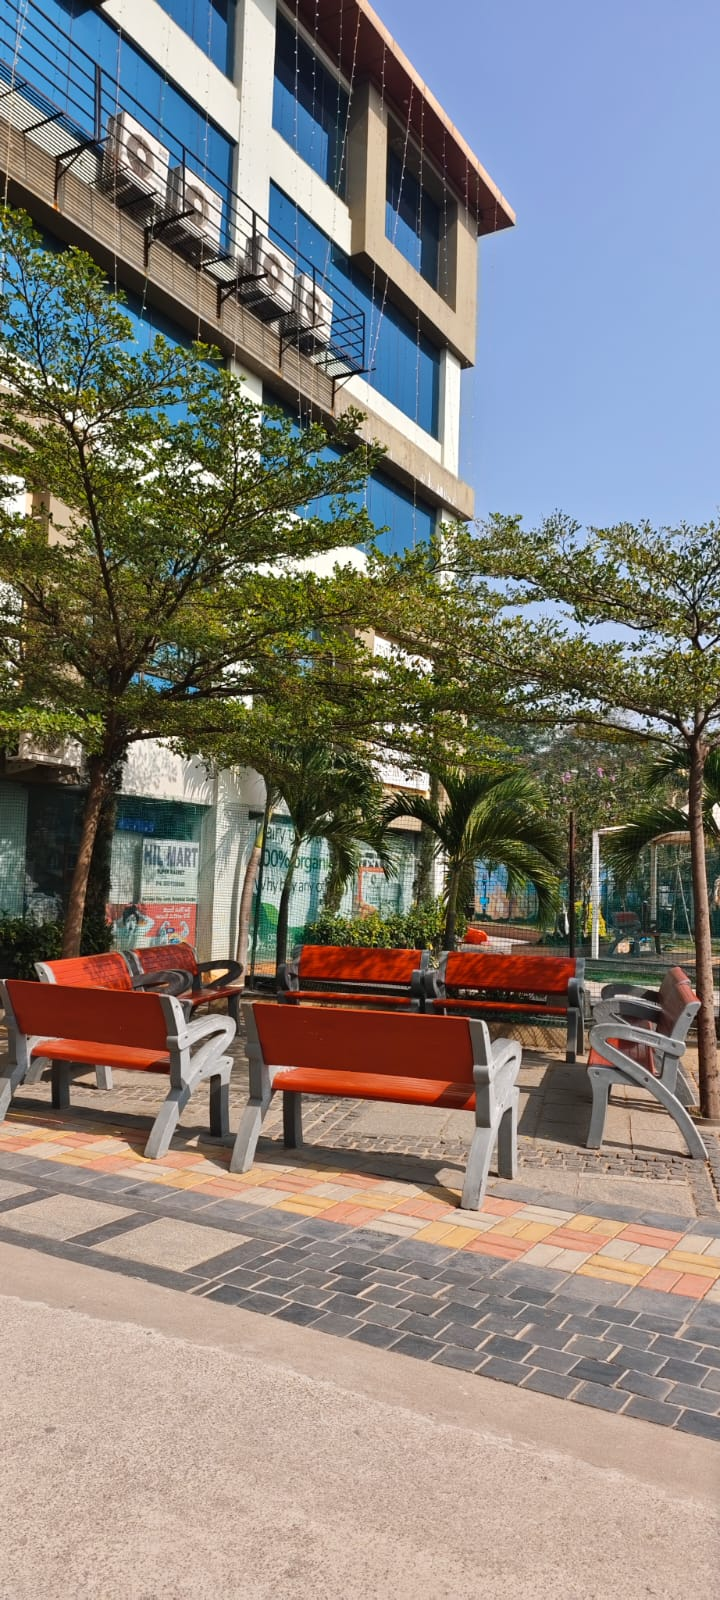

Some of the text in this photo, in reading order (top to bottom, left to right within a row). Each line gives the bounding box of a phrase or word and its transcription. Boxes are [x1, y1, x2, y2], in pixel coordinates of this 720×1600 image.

[144, 844, 198, 868] HIL MART
[262, 849, 332, 873] 00% organi
